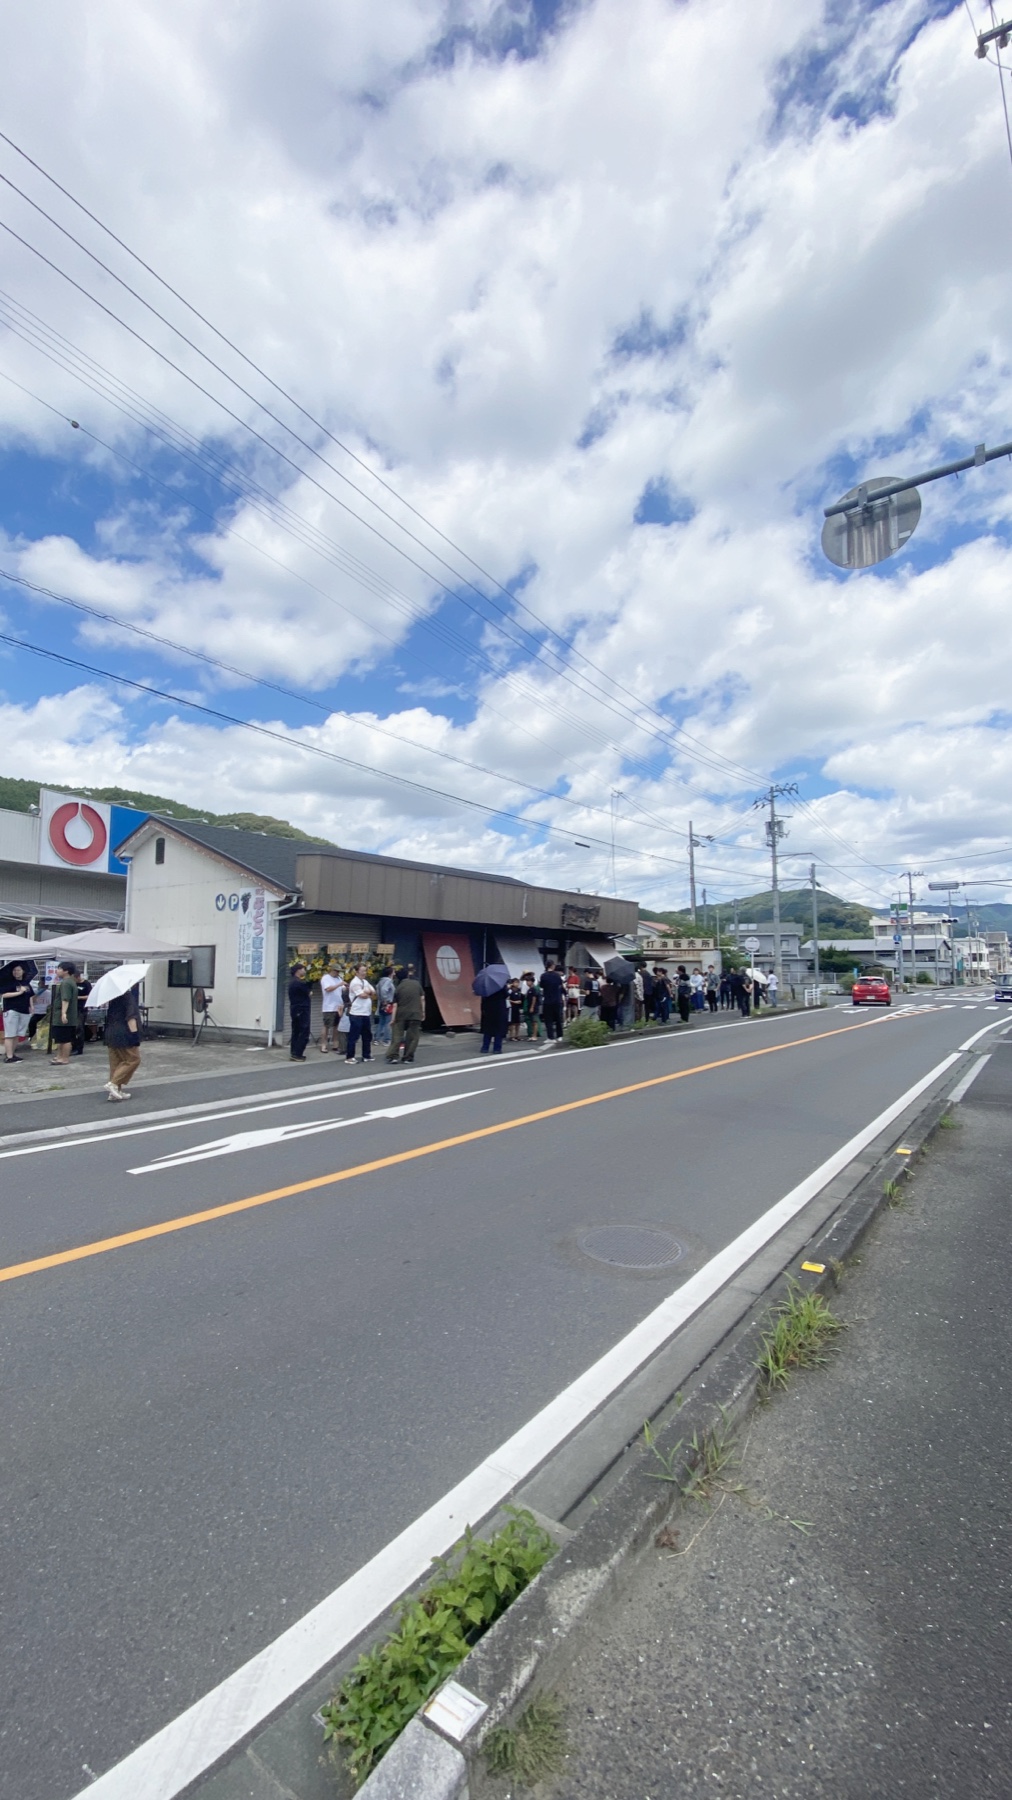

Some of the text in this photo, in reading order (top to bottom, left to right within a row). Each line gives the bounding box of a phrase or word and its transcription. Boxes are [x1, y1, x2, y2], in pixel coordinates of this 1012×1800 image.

[231, 895, 237, 910] P
[647, 940, 710, 948] 灯油販売所
